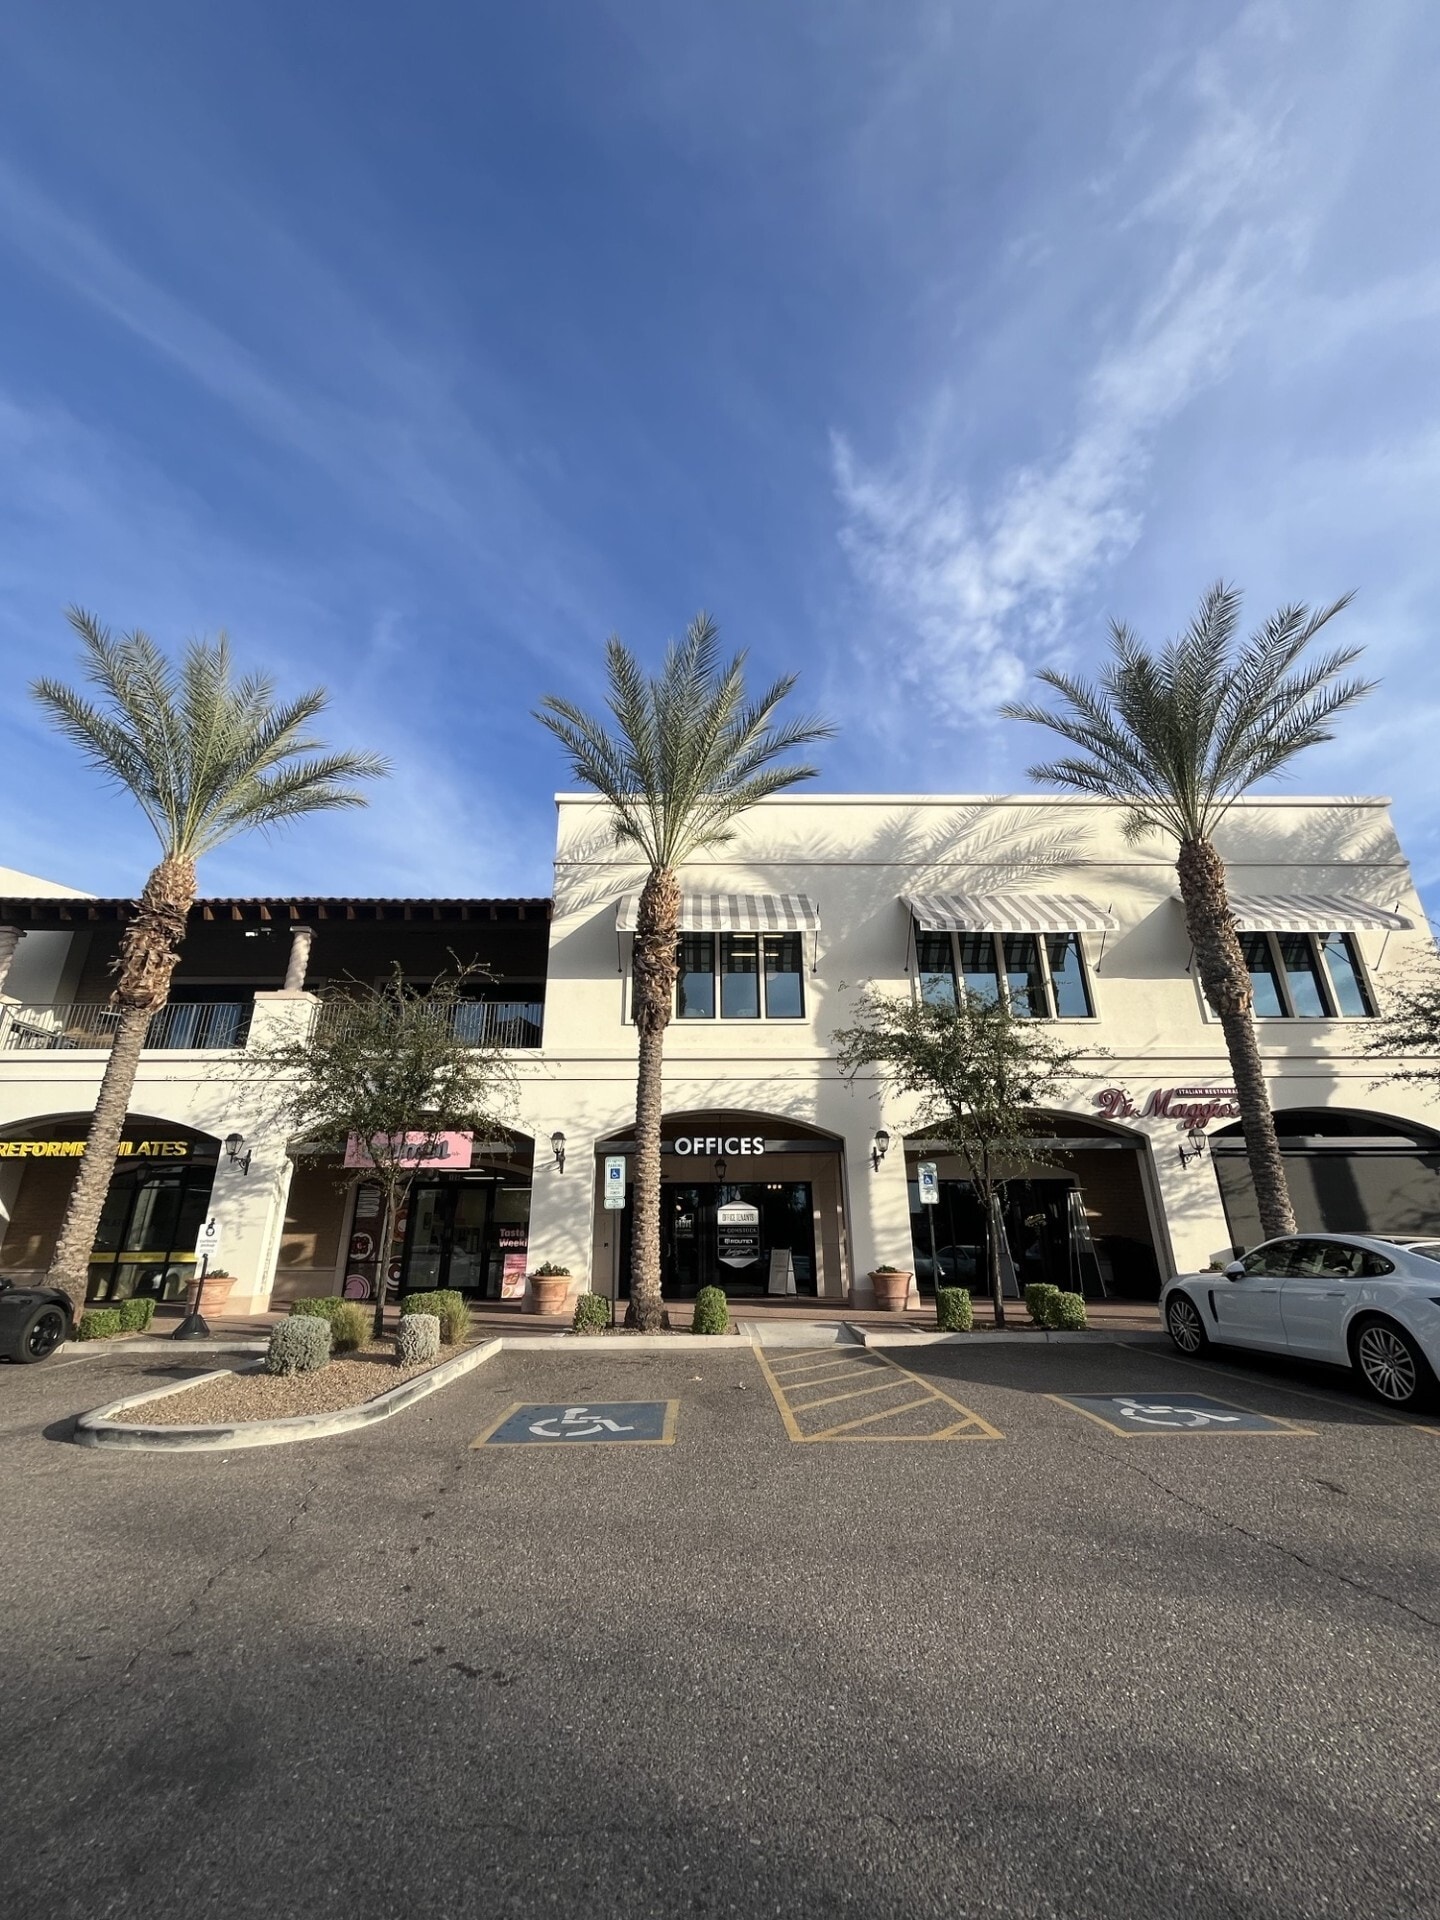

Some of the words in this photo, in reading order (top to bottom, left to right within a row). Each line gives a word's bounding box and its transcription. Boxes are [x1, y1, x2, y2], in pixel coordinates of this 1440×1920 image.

[1134, 1088, 1240, 1129] Maggio
[0, 1141, 88, 1157] REFORME
[117, 1141, 188, 1156] ILATES
[674, 1137, 764, 1155] OFFICES
[499, 1238, 528, 1247] Weekl
